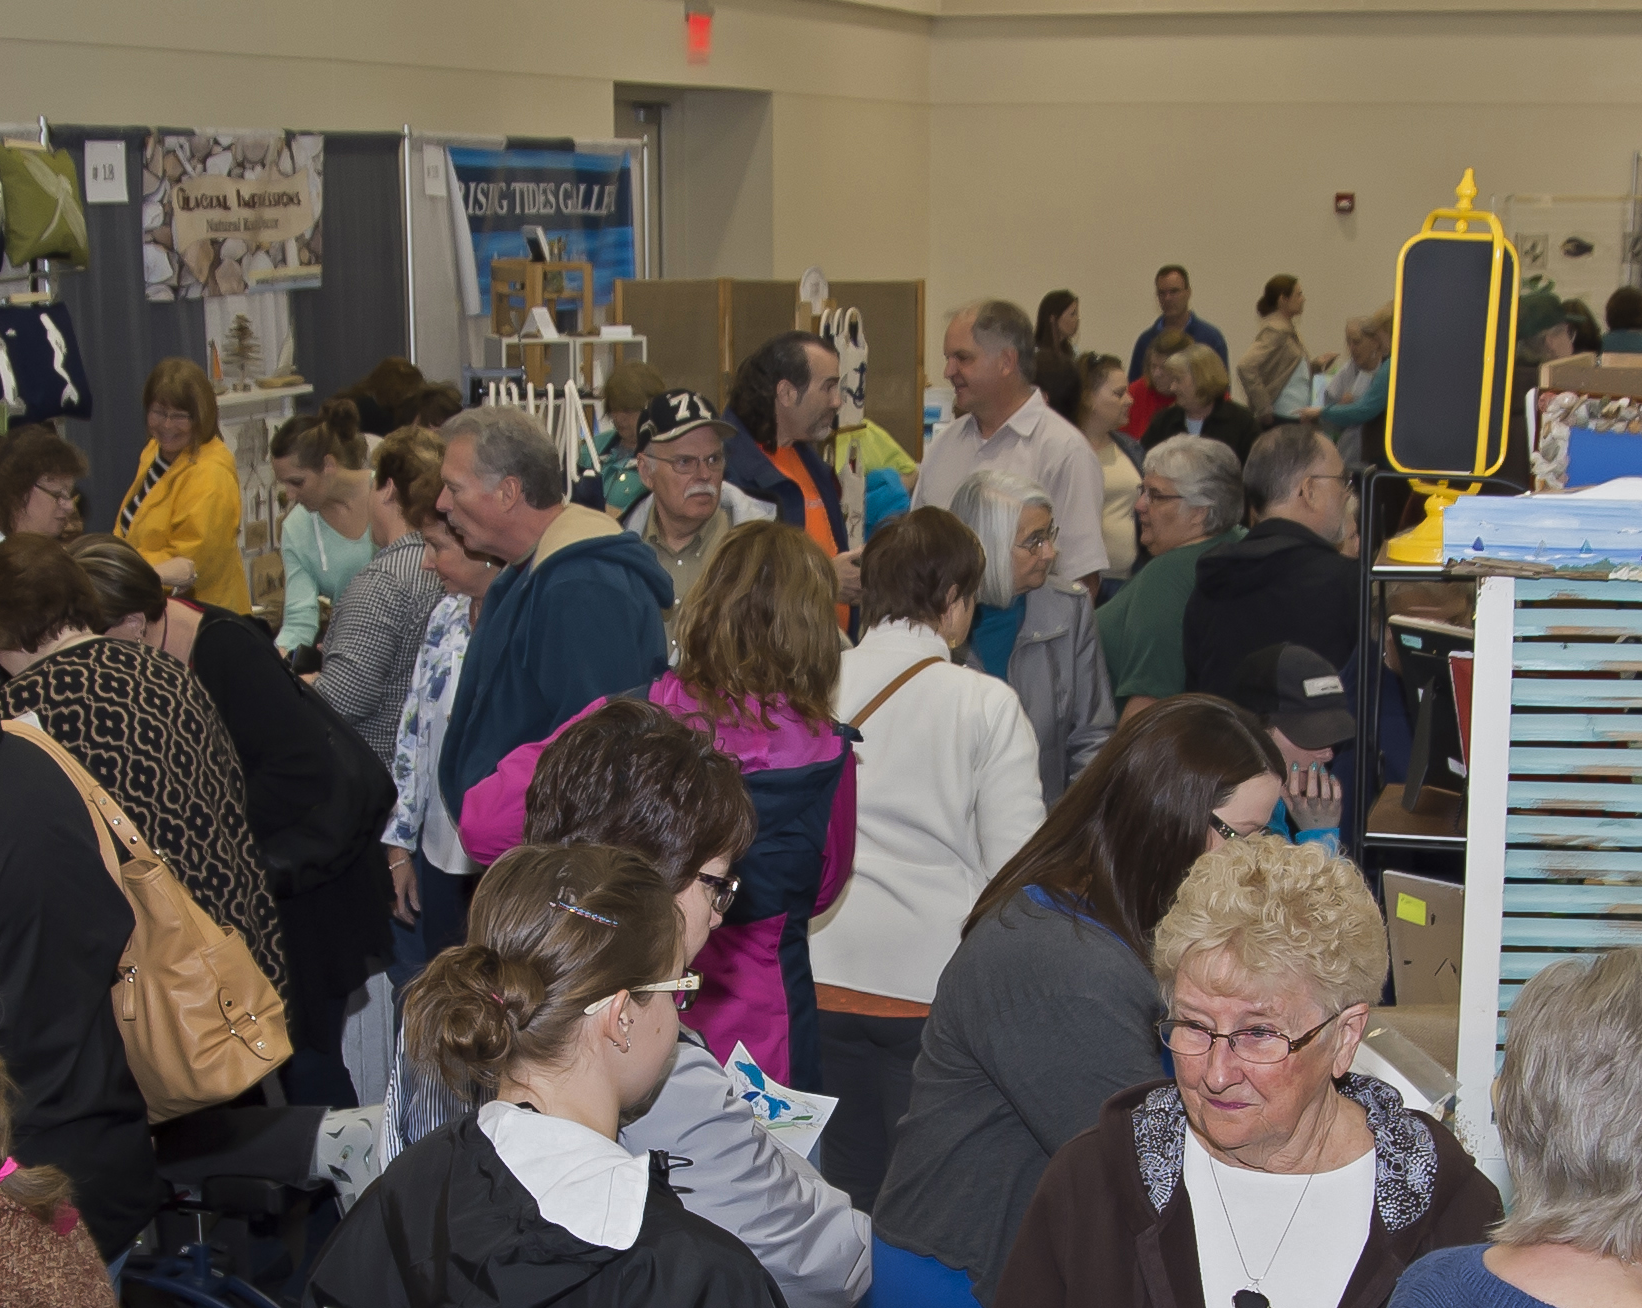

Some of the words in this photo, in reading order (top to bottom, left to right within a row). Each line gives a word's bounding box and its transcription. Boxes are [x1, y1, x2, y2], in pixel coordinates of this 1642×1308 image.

[103, 163, 115, 181] 18
[510, 181, 556, 215] TIDES
[666, 391, 712, 421] 71
